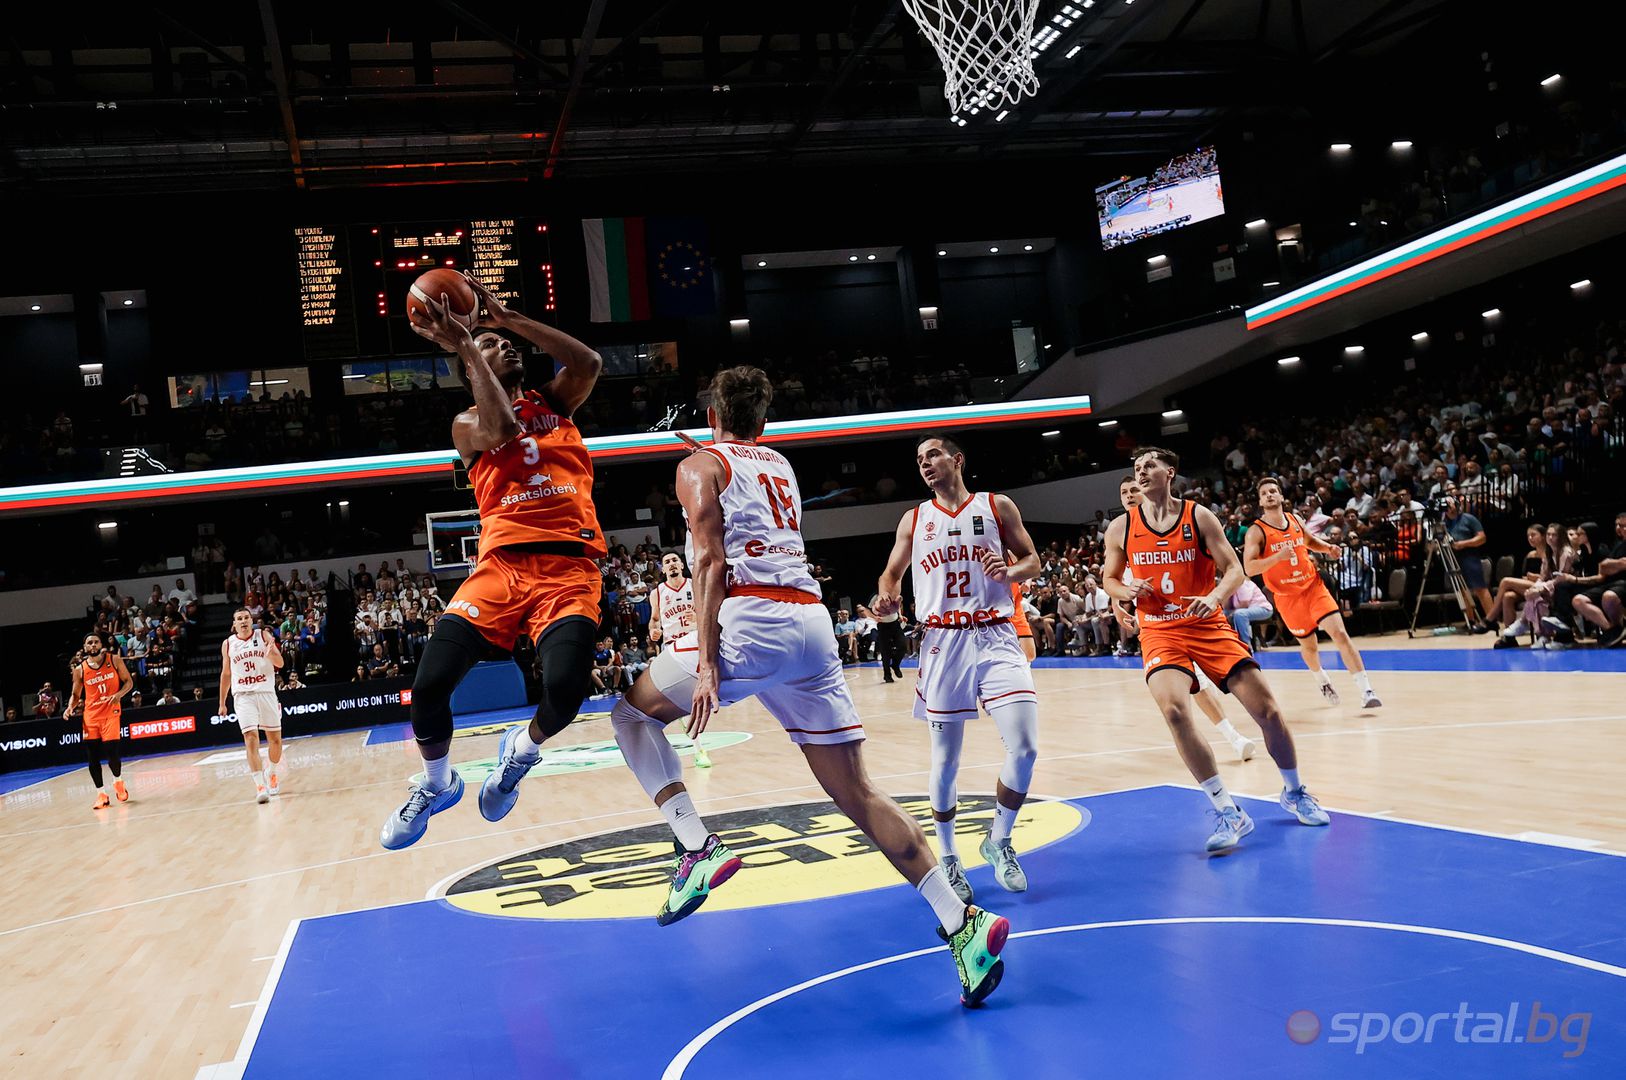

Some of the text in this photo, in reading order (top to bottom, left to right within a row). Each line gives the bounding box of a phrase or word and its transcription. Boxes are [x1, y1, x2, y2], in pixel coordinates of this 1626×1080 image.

[520, 436, 540, 465] 3
[757, 473, 799, 531] 15
[920, 545, 989, 575] BULGAR
[1132, 548, 1196, 565] NEDERLAND
[946, 571, 971, 599] 22
[1160, 571, 1175, 594] 6
[926, 607, 1000, 629] efbet
[233, 650, 265, 664] BULGARIA
[244, 661, 256, 672] 34
[238, 673, 267, 685] efbet
[97, 683, 107, 694] 11
[284, 702, 328, 716] VISION
[336, 699, 355, 711] JOIN
[357, 697, 369, 708] US
[370, 696, 383, 707] ON
[385, 693, 400, 705] THE
[59, 733, 81, 745] JOIN
[132, 722, 170, 736] SPORTS
[171, 719, 193, 731] SIDE
[0, 737, 46, 751] VISION
